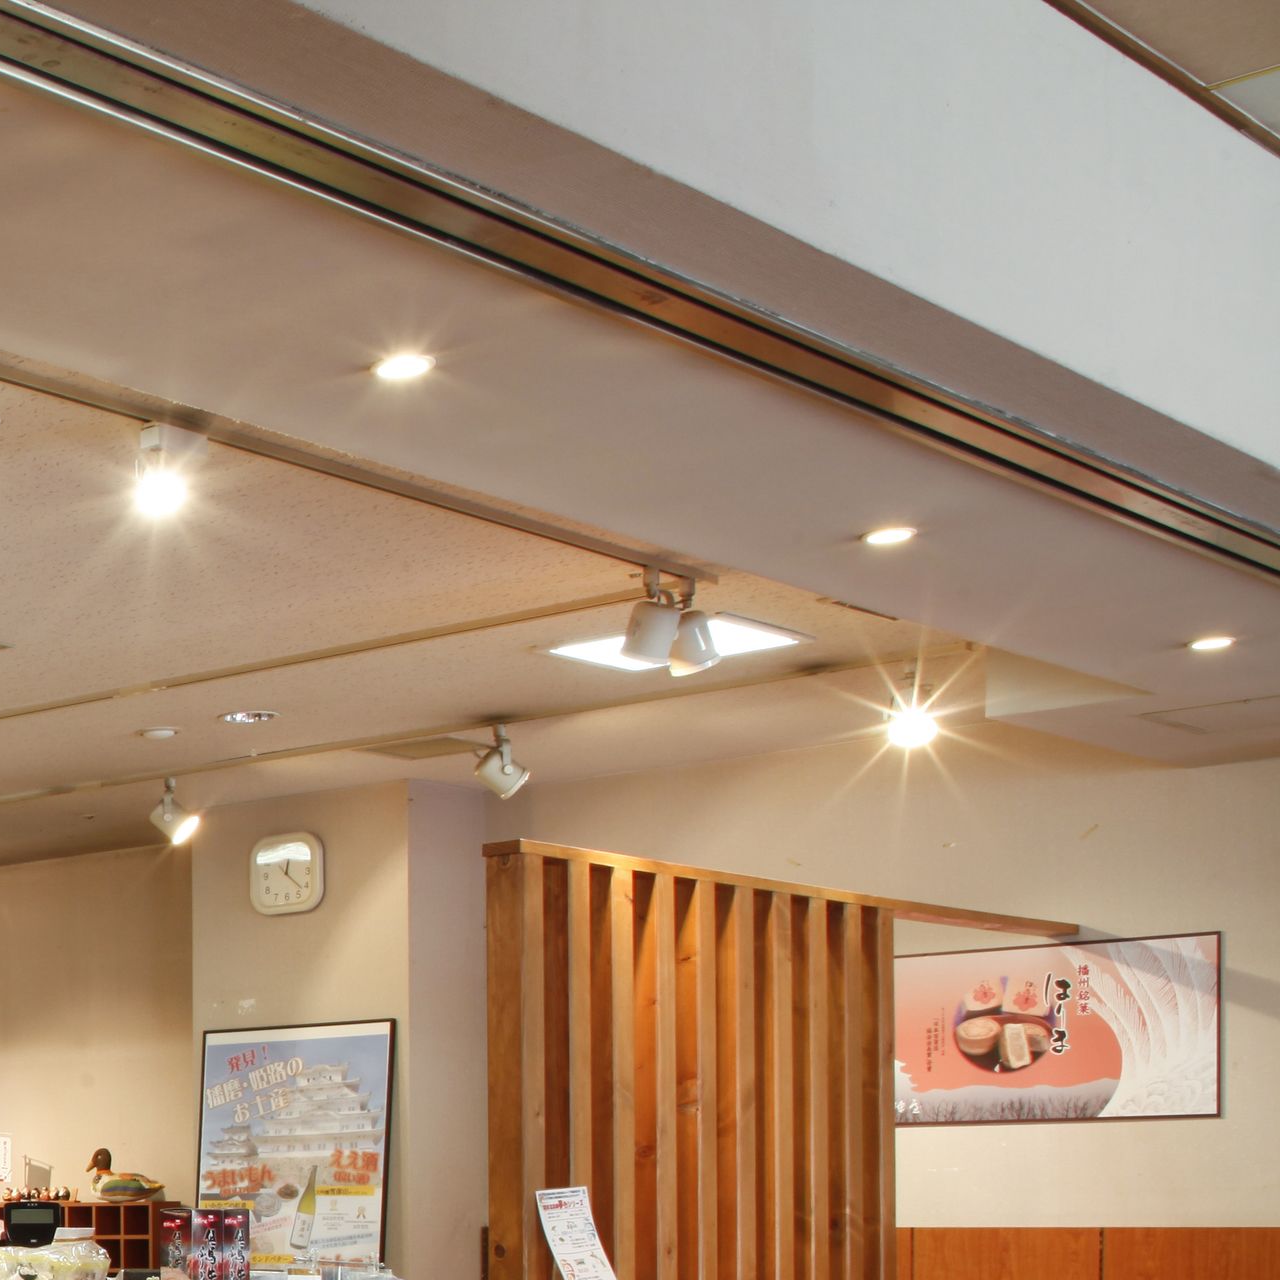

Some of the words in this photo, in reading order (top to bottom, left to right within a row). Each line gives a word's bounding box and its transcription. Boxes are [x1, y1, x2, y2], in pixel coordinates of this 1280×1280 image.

[206, 1057, 303, 1109] 播磨・姫路の
[233, 1087, 290, 1123] お土産
